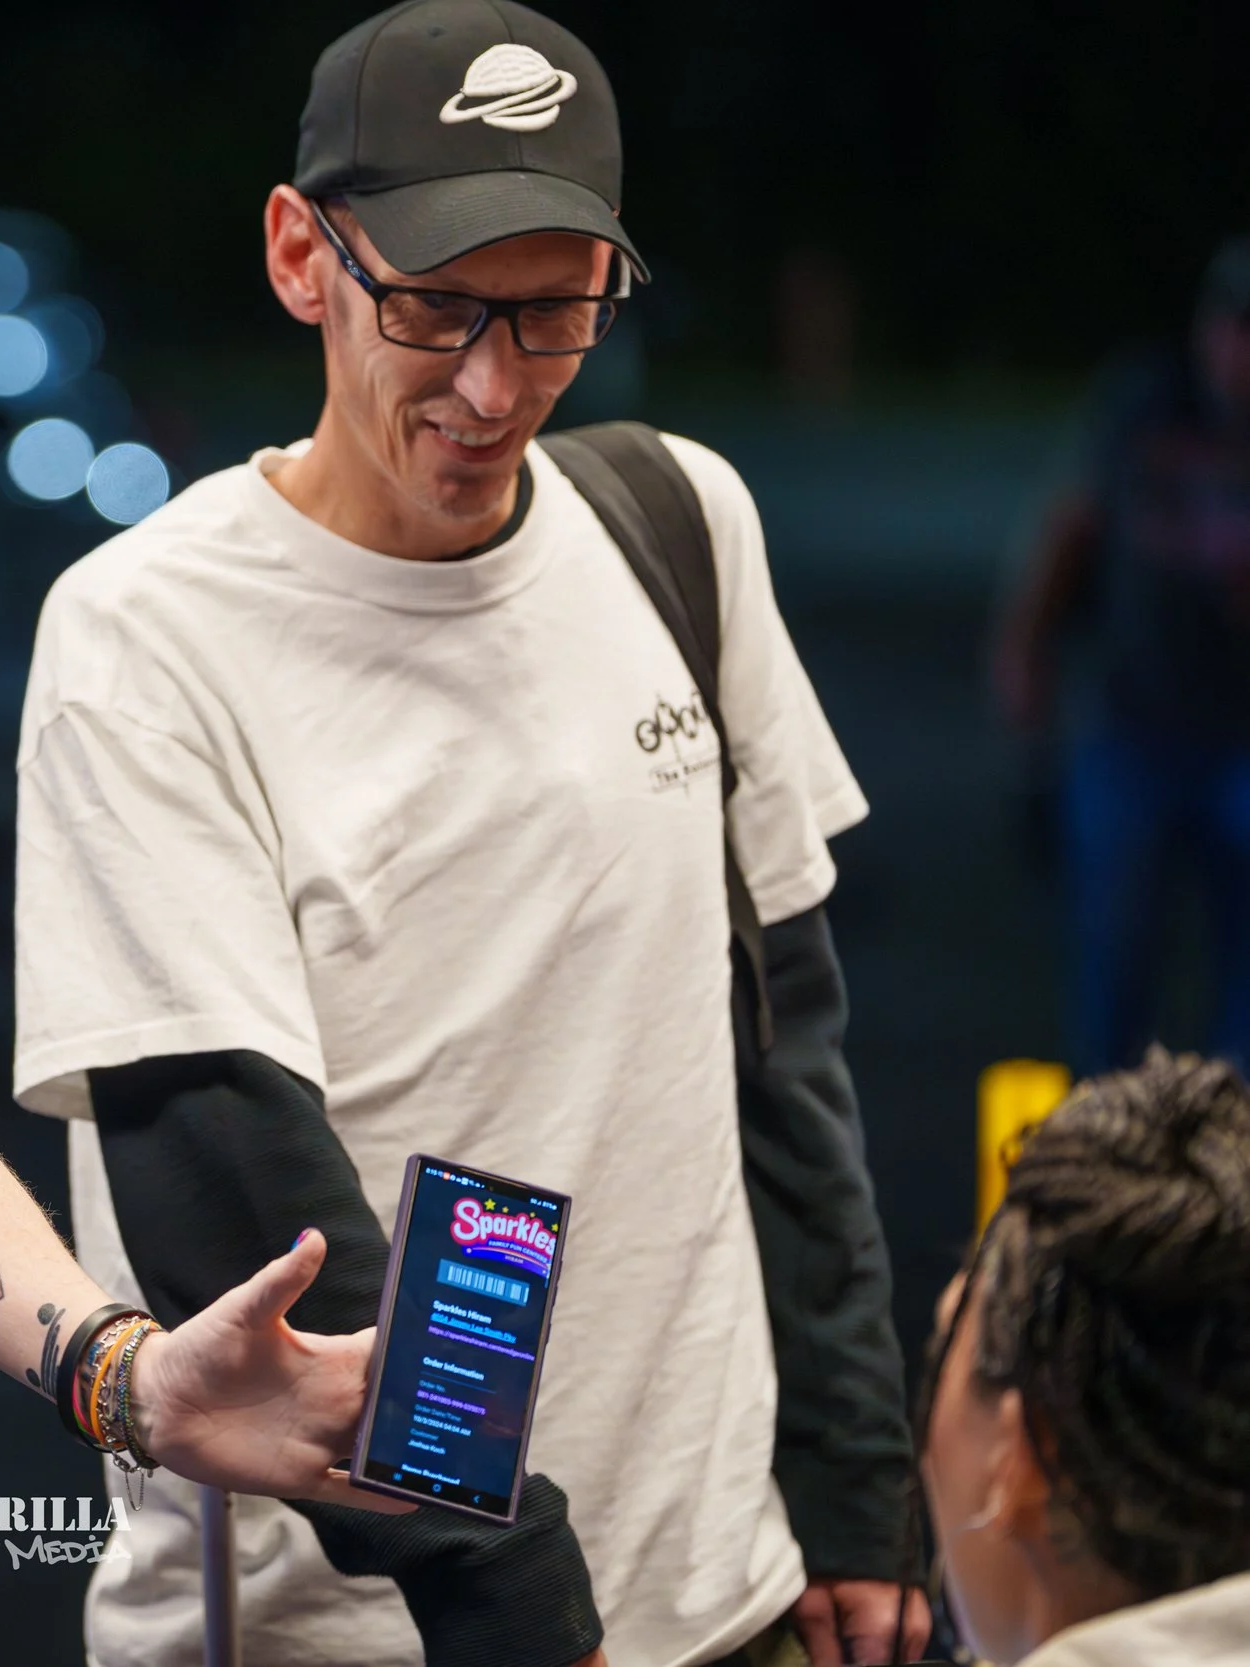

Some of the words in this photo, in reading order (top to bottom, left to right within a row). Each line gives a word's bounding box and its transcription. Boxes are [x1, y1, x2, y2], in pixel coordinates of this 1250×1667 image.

[453, 1200, 556, 1255] Sparkles
[432, 1300, 467, 1318] Sparkles
[467, 1310, 492, 1323] Hiram
[422, 1356, 443, 1368] Order
[443, 1362, 484, 1380] Information
